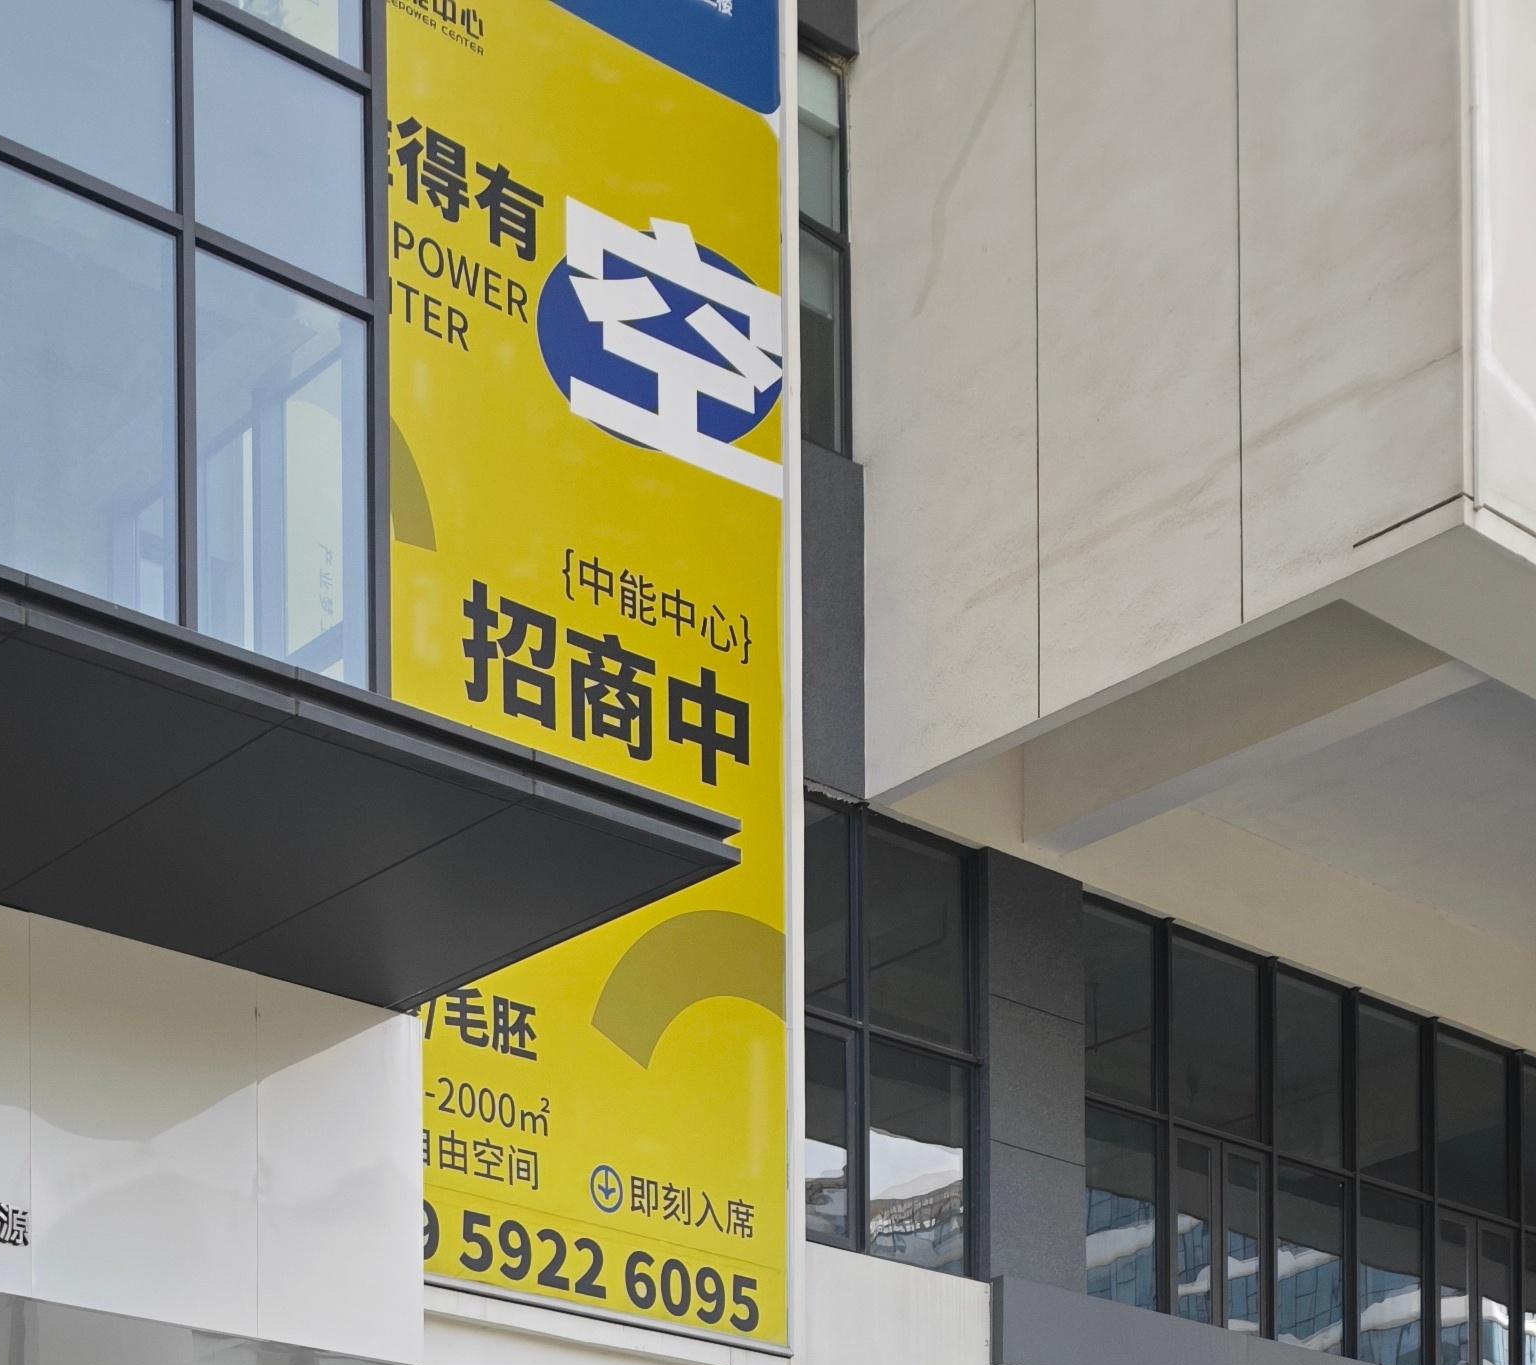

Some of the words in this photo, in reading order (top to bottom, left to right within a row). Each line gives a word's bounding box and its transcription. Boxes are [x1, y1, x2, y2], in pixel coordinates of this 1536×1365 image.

[441, 25, 485, 56] CENTER
[388, 116, 544, 262] 得有
[389, 277, 469, 352] TER
[393, 221, 528, 324] POWER
[565, 195, 783, 500] 空
[562, 549, 752, 665] {中能中心}
[462, 579, 750, 786] 招商中
[630, 1175, 755, 1239] 即刻入席
[459, 1210, 607, 1300] 5922
[625, 1250, 760, 1333] 6095
